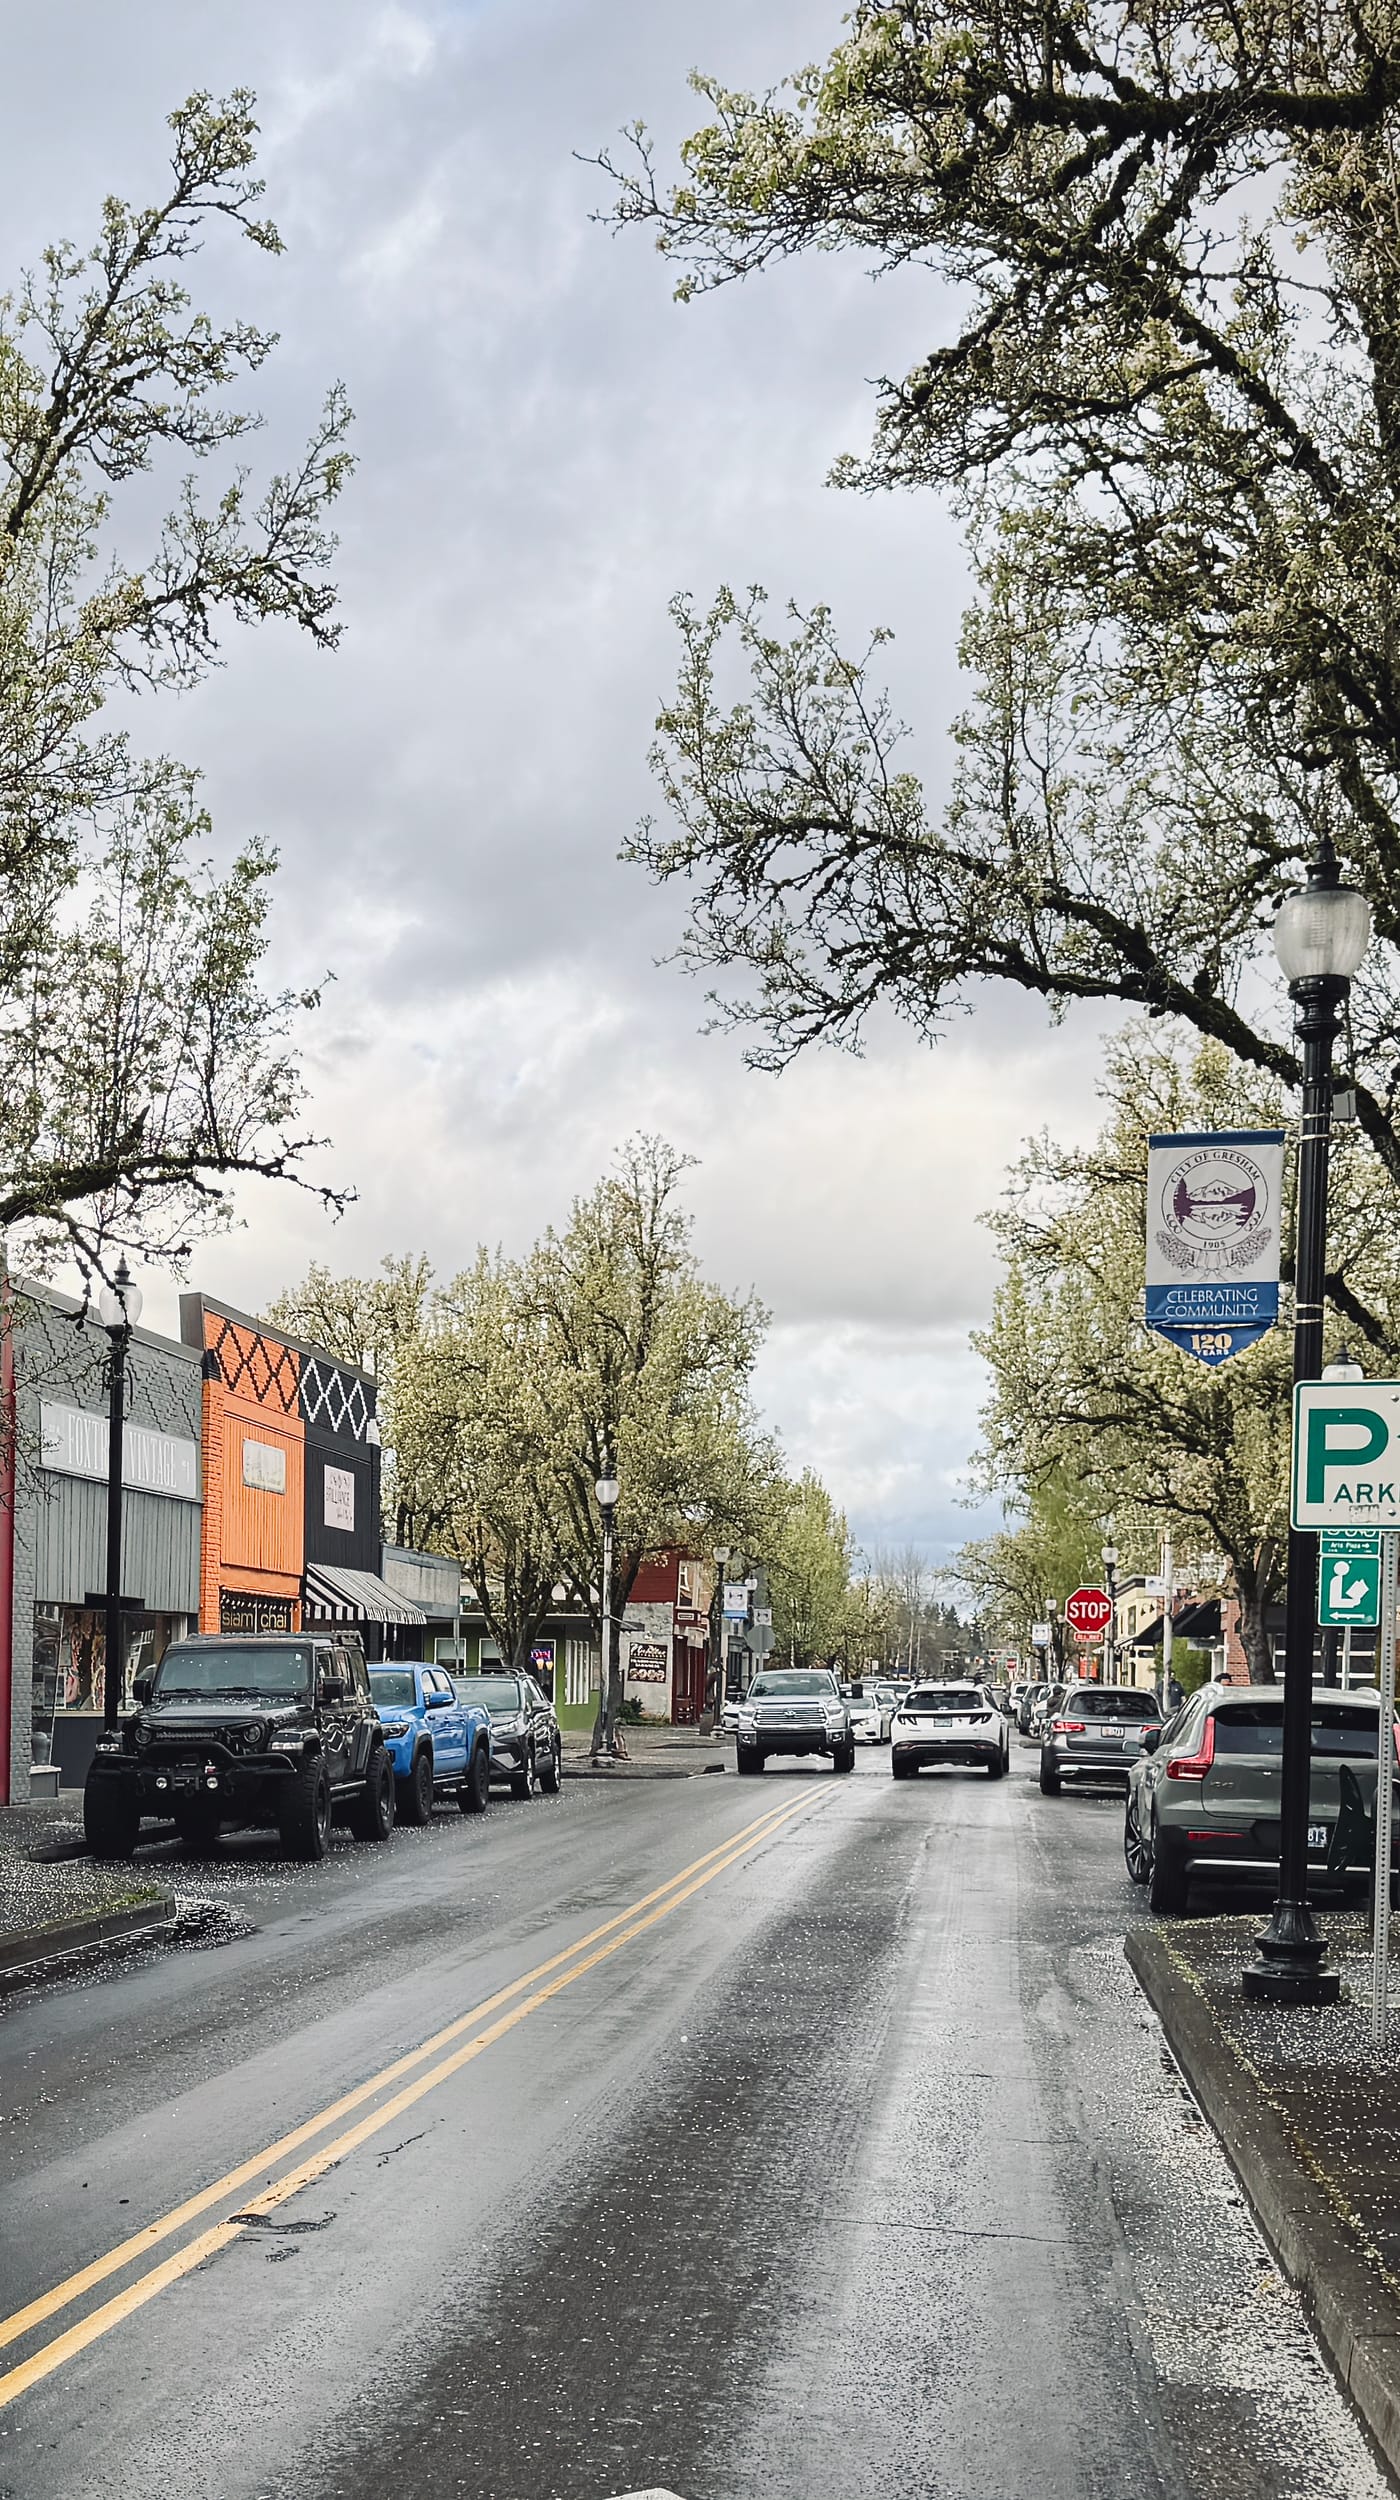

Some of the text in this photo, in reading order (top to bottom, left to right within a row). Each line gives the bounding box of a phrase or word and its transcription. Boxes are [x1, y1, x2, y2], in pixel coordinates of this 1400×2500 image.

[1171, 1151, 1261, 1183] CITY OF GRESHAM
[1203, 1240, 1226, 1249] 1905
[1166, 1288, 1258, 1303] CELEBRATING
[1165, 1303, 1259, 1317] COMMUNITY
[1190, 1333, 1233, 1350] 120
[67, 1413, 112, 1475] FOXTR
[129, 1431, 178, 1488] VINTAGE
[1069, 1601, 1110, 1619] STOP
[222, 1611, 254, 1628] siam
